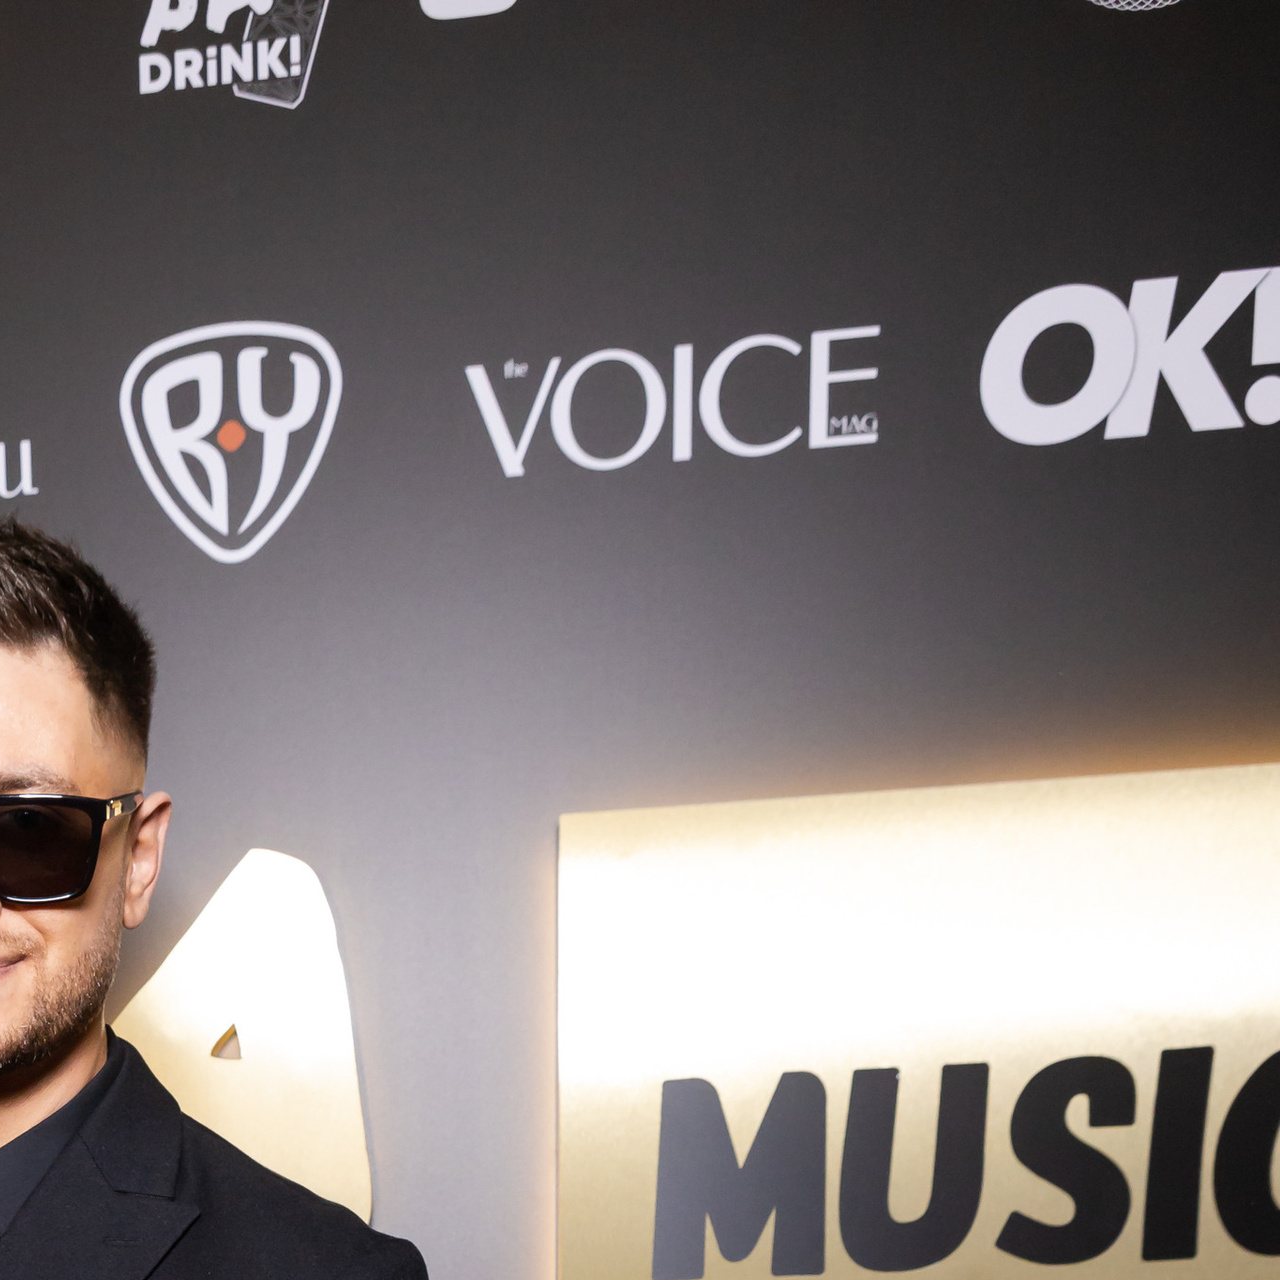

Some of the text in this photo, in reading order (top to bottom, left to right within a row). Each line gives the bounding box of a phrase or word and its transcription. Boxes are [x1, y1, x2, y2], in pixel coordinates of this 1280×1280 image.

[504, 358, 529, 379] the
[464, 326, 881, 478] VOICE
[830, 412, 878, 435] MAG
